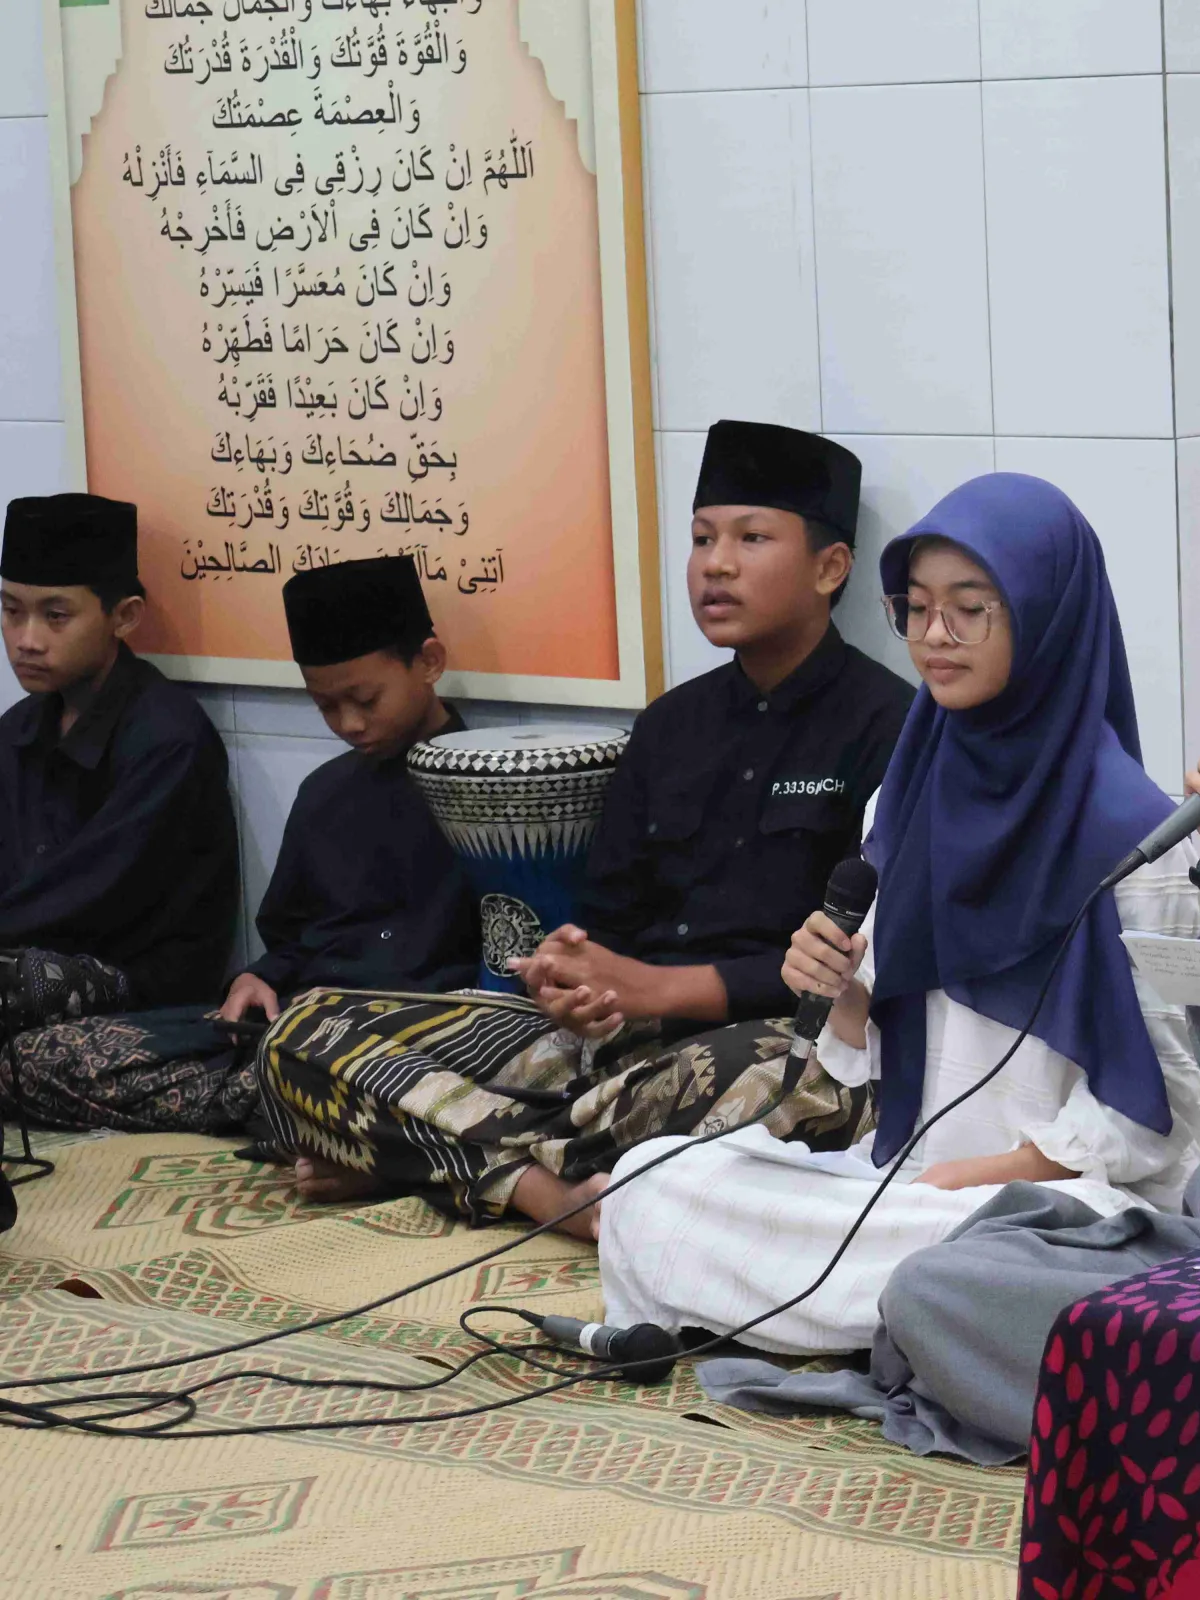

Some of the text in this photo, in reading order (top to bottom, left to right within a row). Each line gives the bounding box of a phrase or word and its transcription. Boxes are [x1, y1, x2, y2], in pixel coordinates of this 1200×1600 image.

[392, 145, 435, 193] كَانَ
[391, 203, 434, 250] كَانَ
[356, 261, 398, 308] كَانَ
[359, 318, 401, 365] كَانَ
[347, 375, 390, 421] كَانَ
